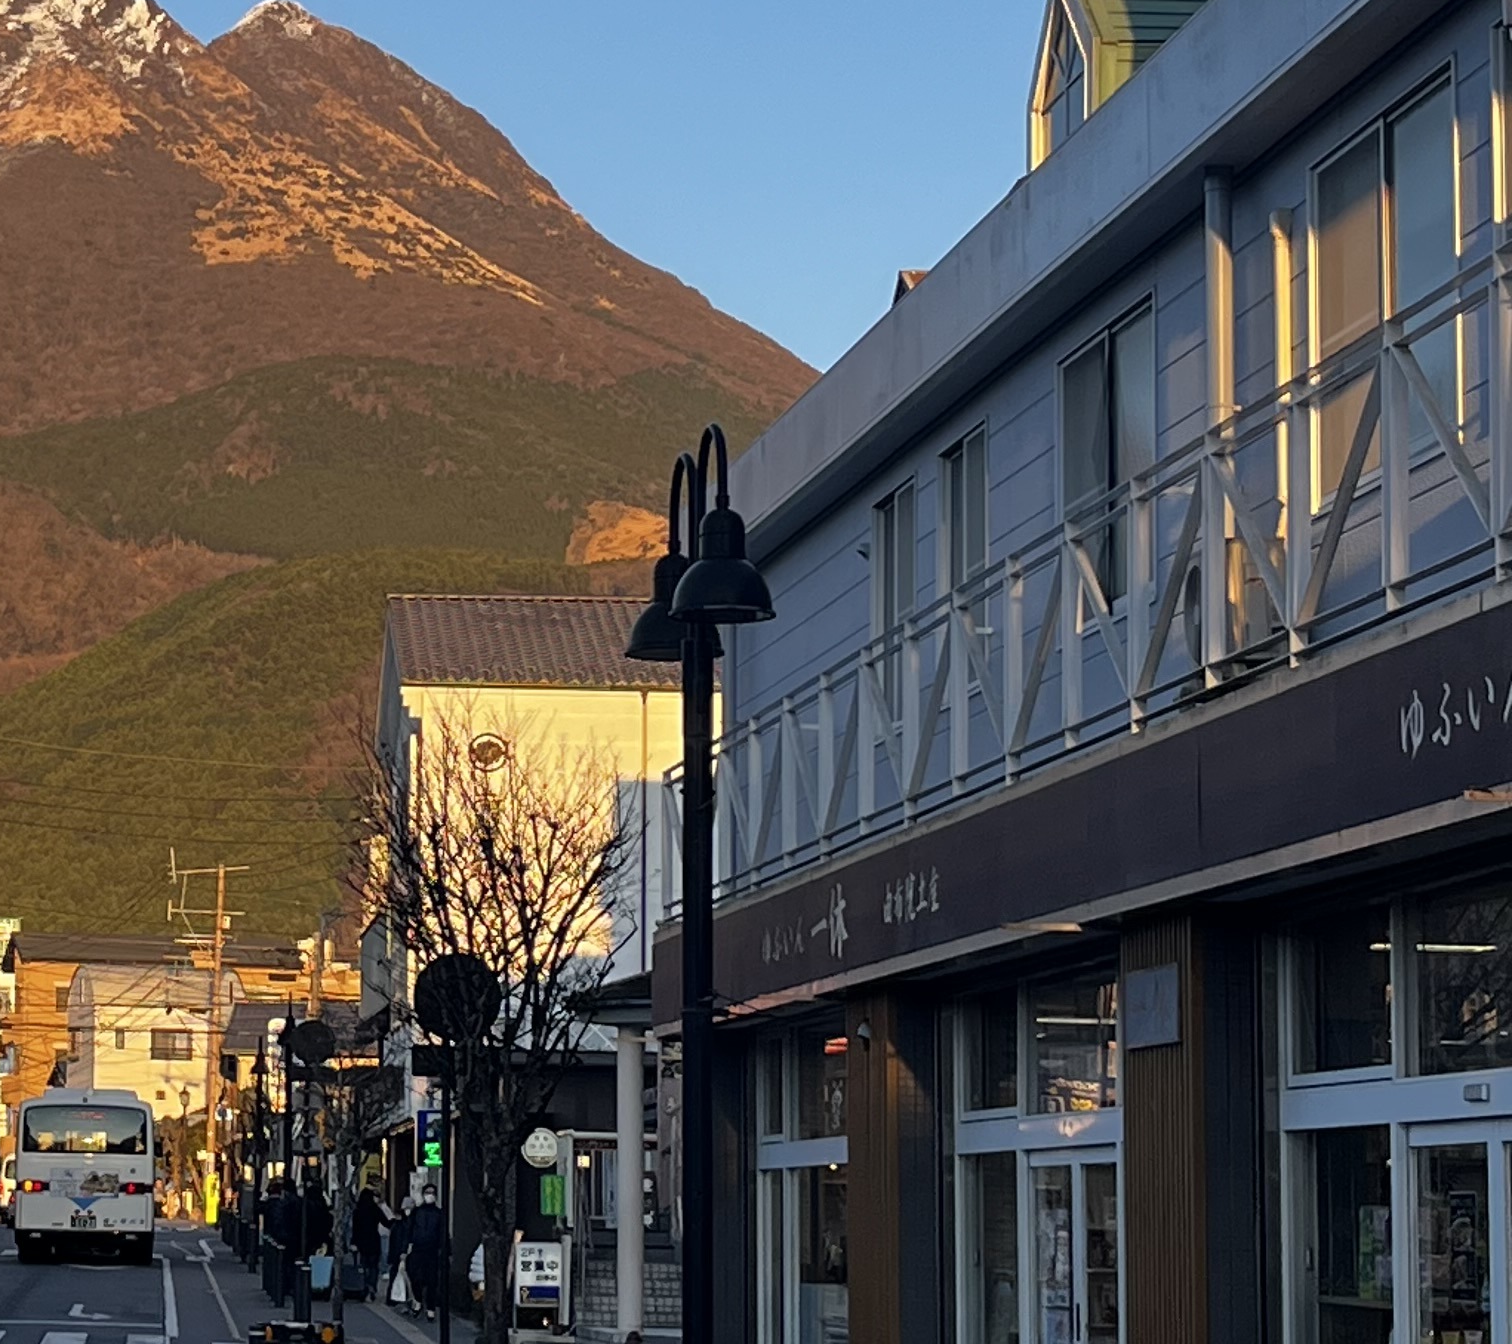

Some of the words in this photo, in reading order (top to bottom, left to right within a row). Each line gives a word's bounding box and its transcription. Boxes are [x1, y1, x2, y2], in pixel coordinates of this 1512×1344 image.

[1399, 675, 1512, 761] ゆふい
[762, 916, 805, 966] ゆふいん
[810, 882, 849, 960] 一休
